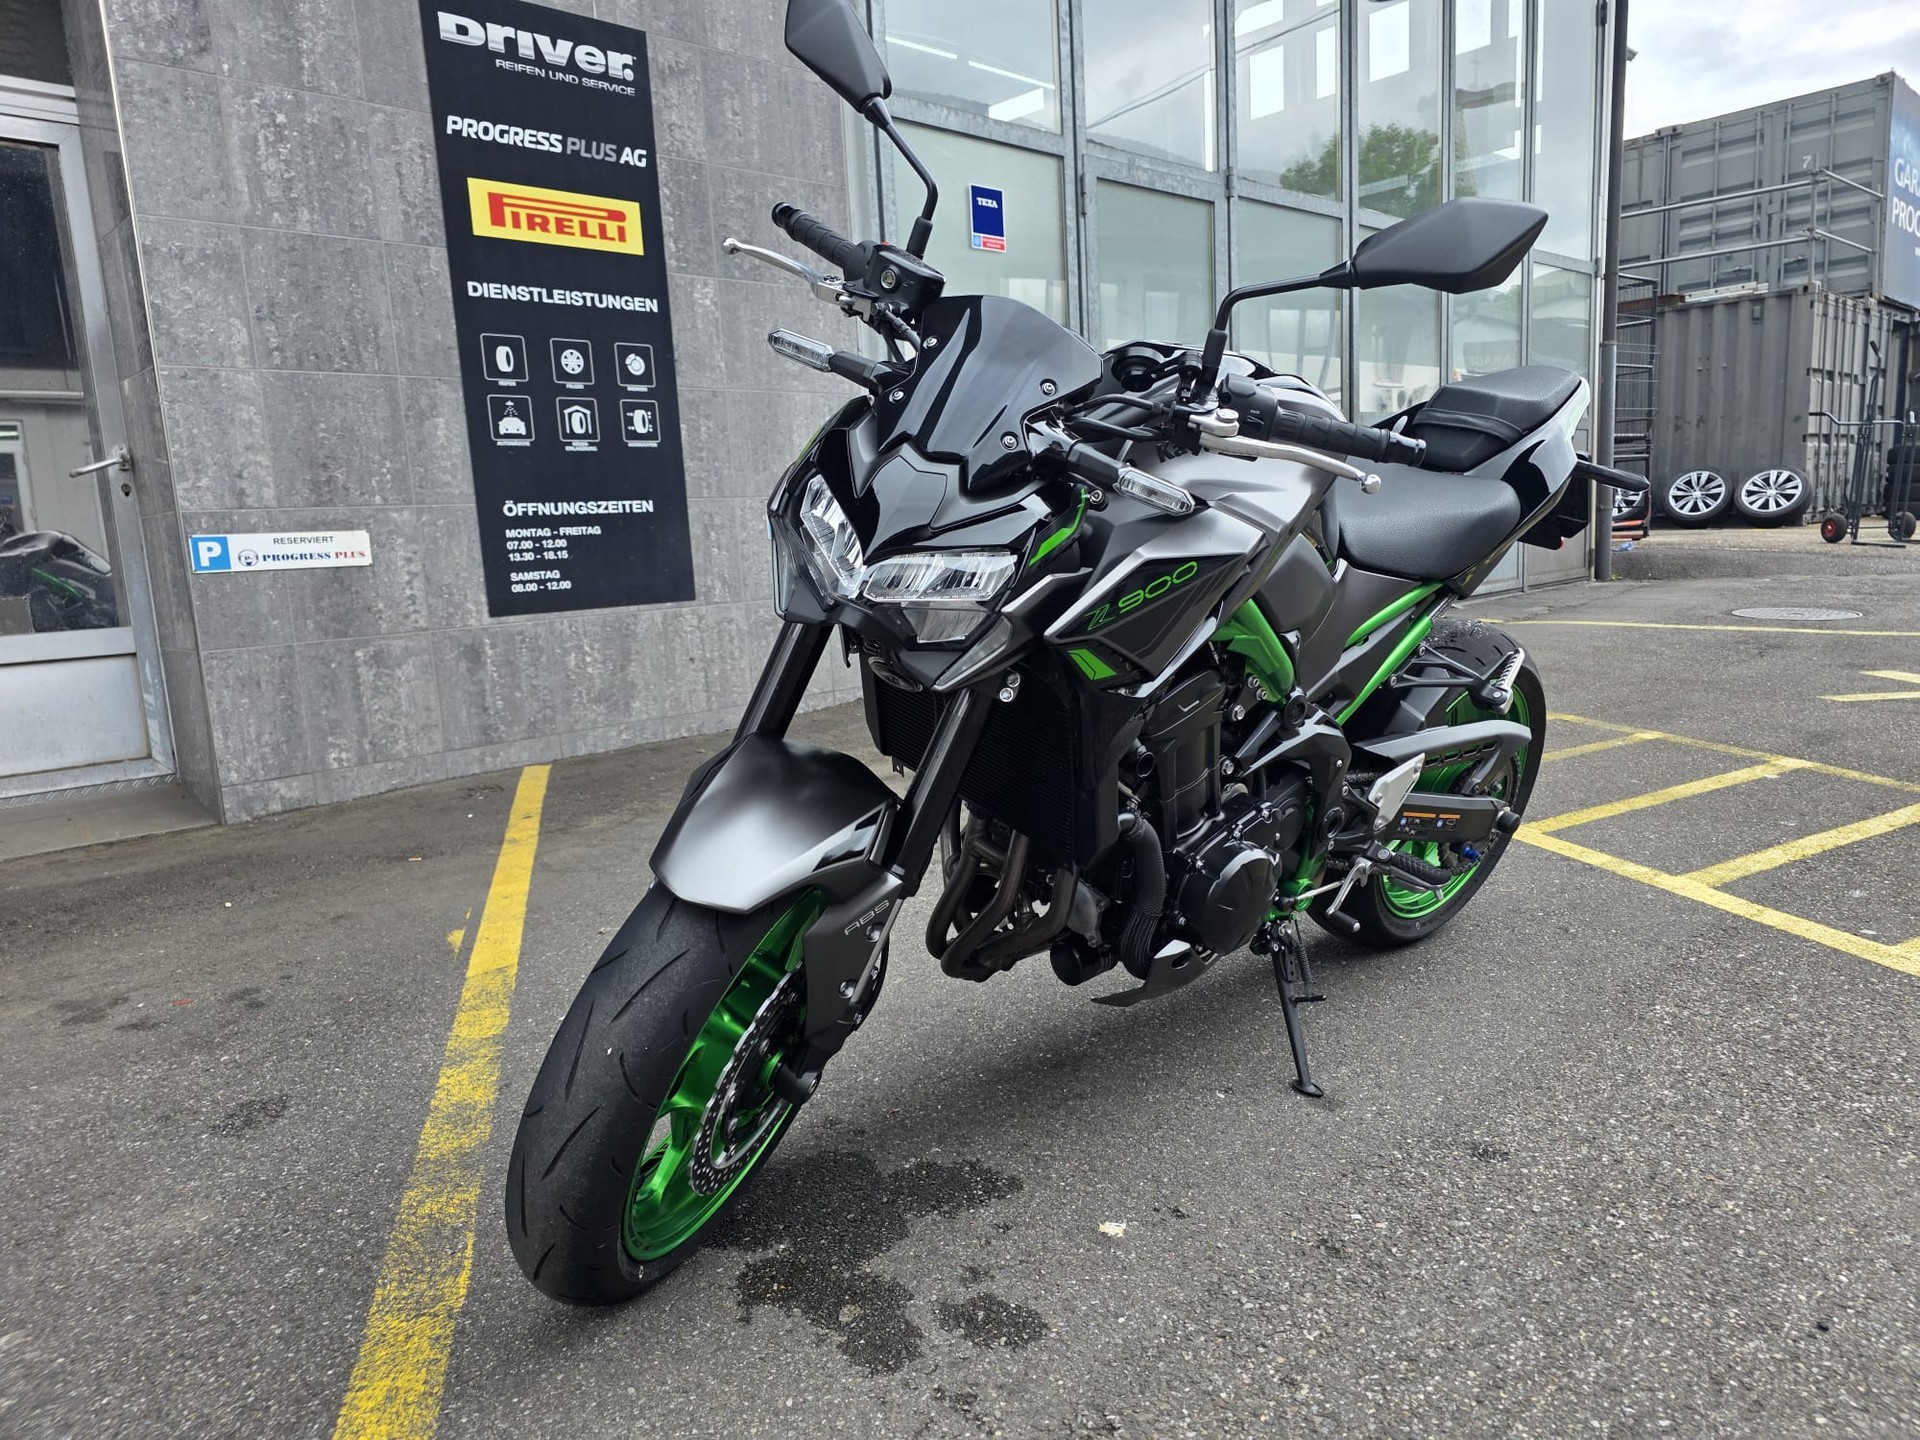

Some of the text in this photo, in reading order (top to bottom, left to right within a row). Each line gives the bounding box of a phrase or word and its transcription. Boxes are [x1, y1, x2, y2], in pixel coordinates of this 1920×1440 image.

[495, 58, 636, 96] REIFEN UND SERVICE
[446, 115, 647, 168] PROGRESS PLUS AG
[1894, 157, 1920, 197] GAR
[487, 191, 627, 243] PIRELLI
[467, 281, 659, 313] DIENSTLEISTUNGEN
[503, 500, 654, 517] ÖFFNUNGSZEITEN
[505, 527, 551, 538] MONTAG
[559, 526, 602, 536] FREITAG
[273, 536, 334, 545] RESERVIERT
[507, 541, 533, 550] 07.00
[542, 539, 567, 548] 12.00
[198, 541, 221, 567] P
[262, 552, 331, 562] PROGRESS
[334, 550, 366, 559] PLUS
[508, 552, 535, 562] 13.30
[543, 550, 568, 560] 18.15
[510, 570, 561, 581] SAMSTAG
[511, 583, 538, 593] 08.00
[547, 581, 572, 591] 12.00
